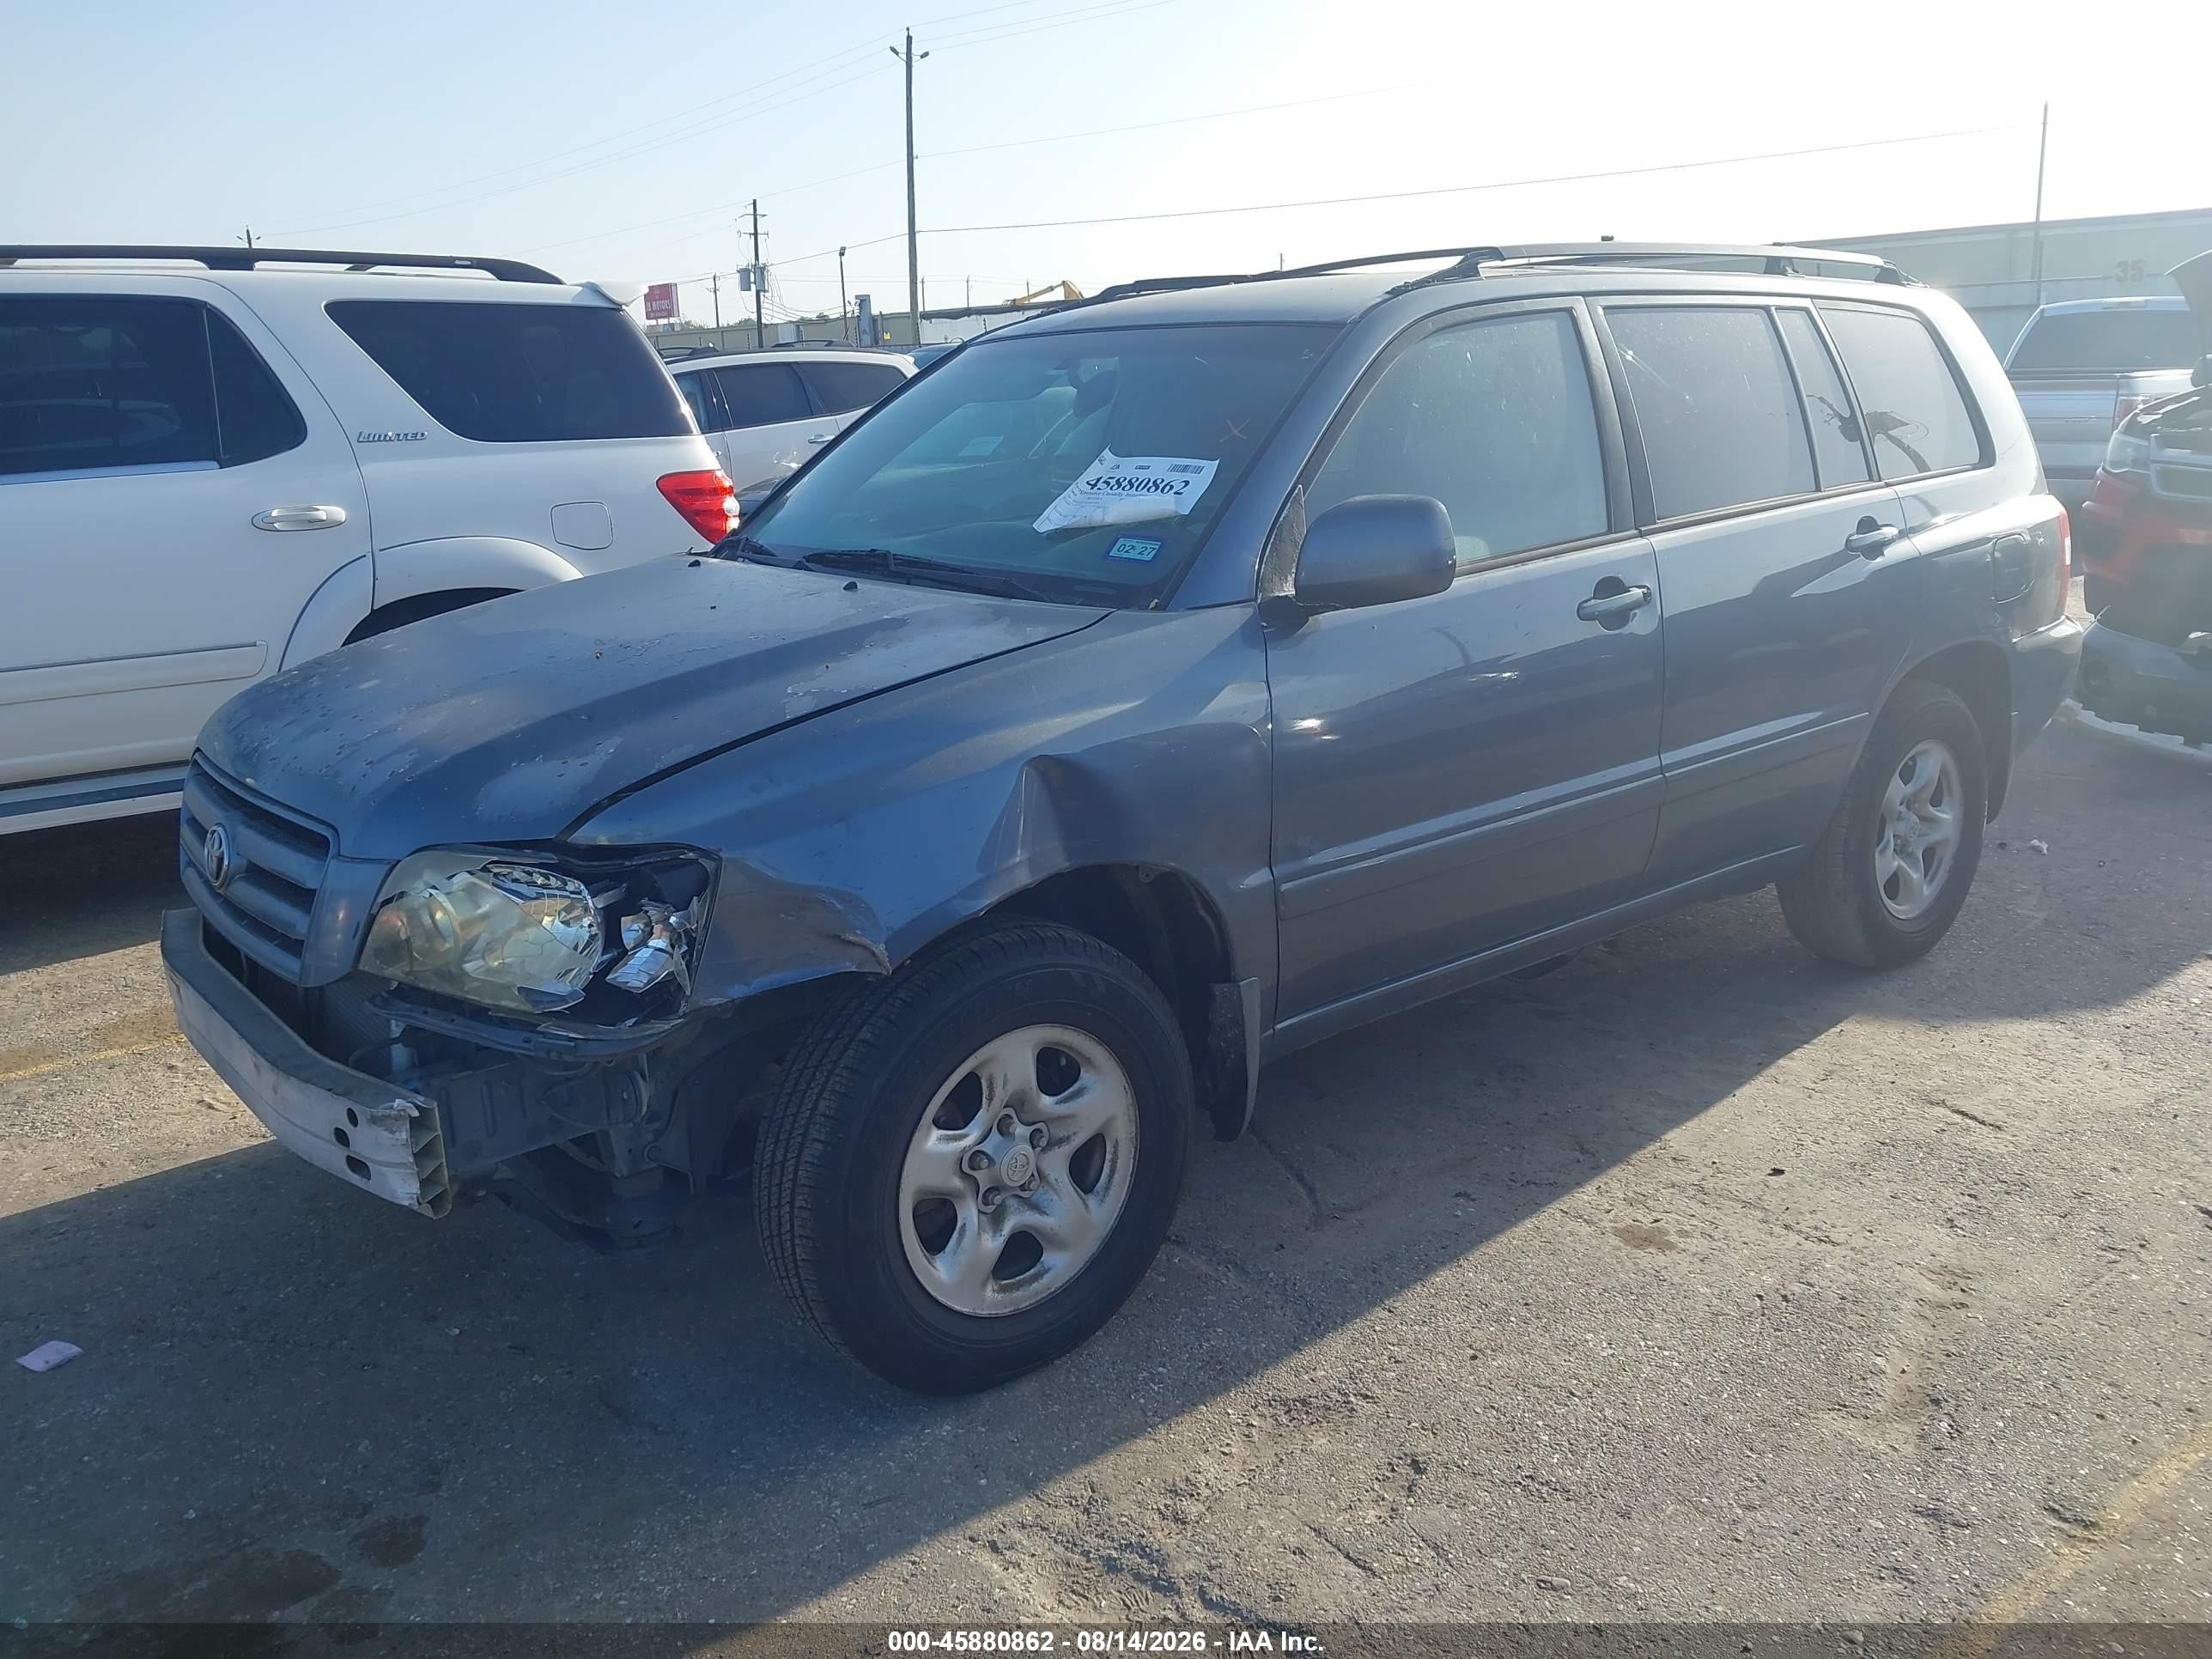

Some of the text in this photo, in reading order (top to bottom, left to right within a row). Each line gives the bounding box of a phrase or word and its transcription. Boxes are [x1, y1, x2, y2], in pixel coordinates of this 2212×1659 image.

[2116, 260, 2144, 283] 35
[1085, 475, 1190, 495] 45880862
[1117, 543, 1133, 554] 02
[1138, 545, 1157, 556] 27
